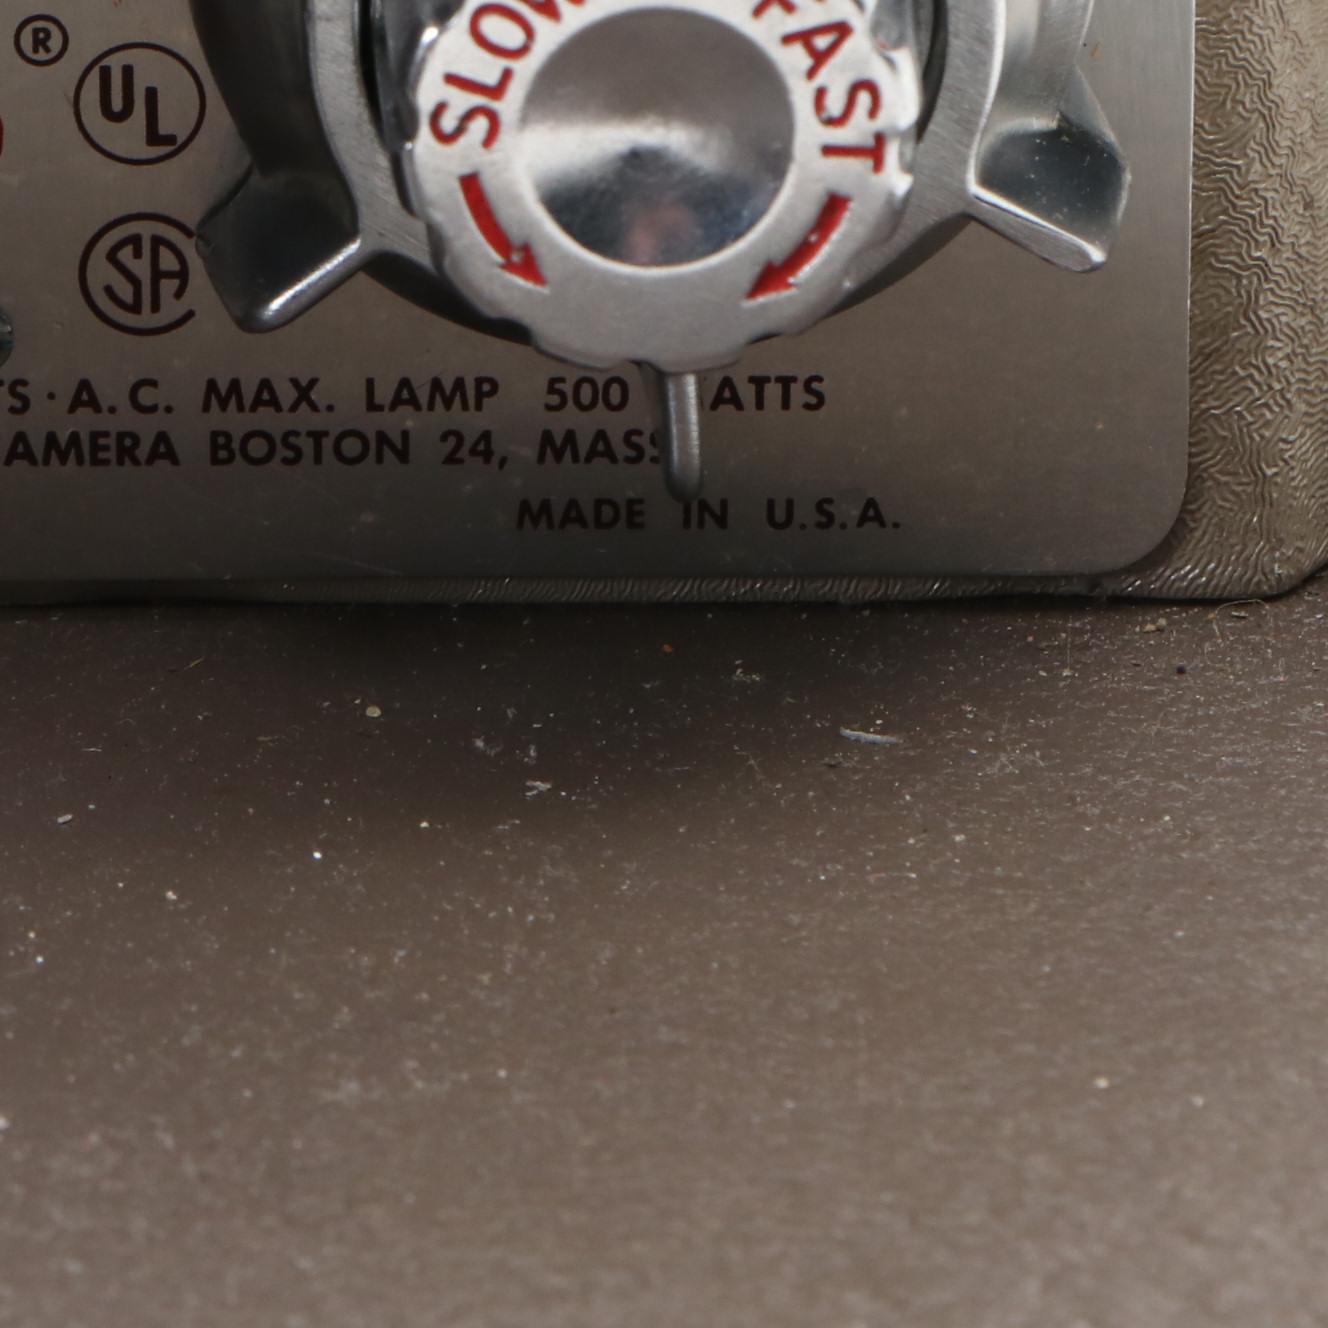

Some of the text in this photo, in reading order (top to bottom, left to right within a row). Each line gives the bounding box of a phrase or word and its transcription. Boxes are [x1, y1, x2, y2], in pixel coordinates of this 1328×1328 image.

[201, 376, 336, 414] MAX.
[365, 375, 501, 413] LAMP
[544, 375, 630, 413] 500
[702, 374, 827, 412] ATTS
[209, 428, 411, 467] BOSTON
[439, 429, 508, 470] 24,
[516, 497, 902, 531] MADE IN U.S.A.
